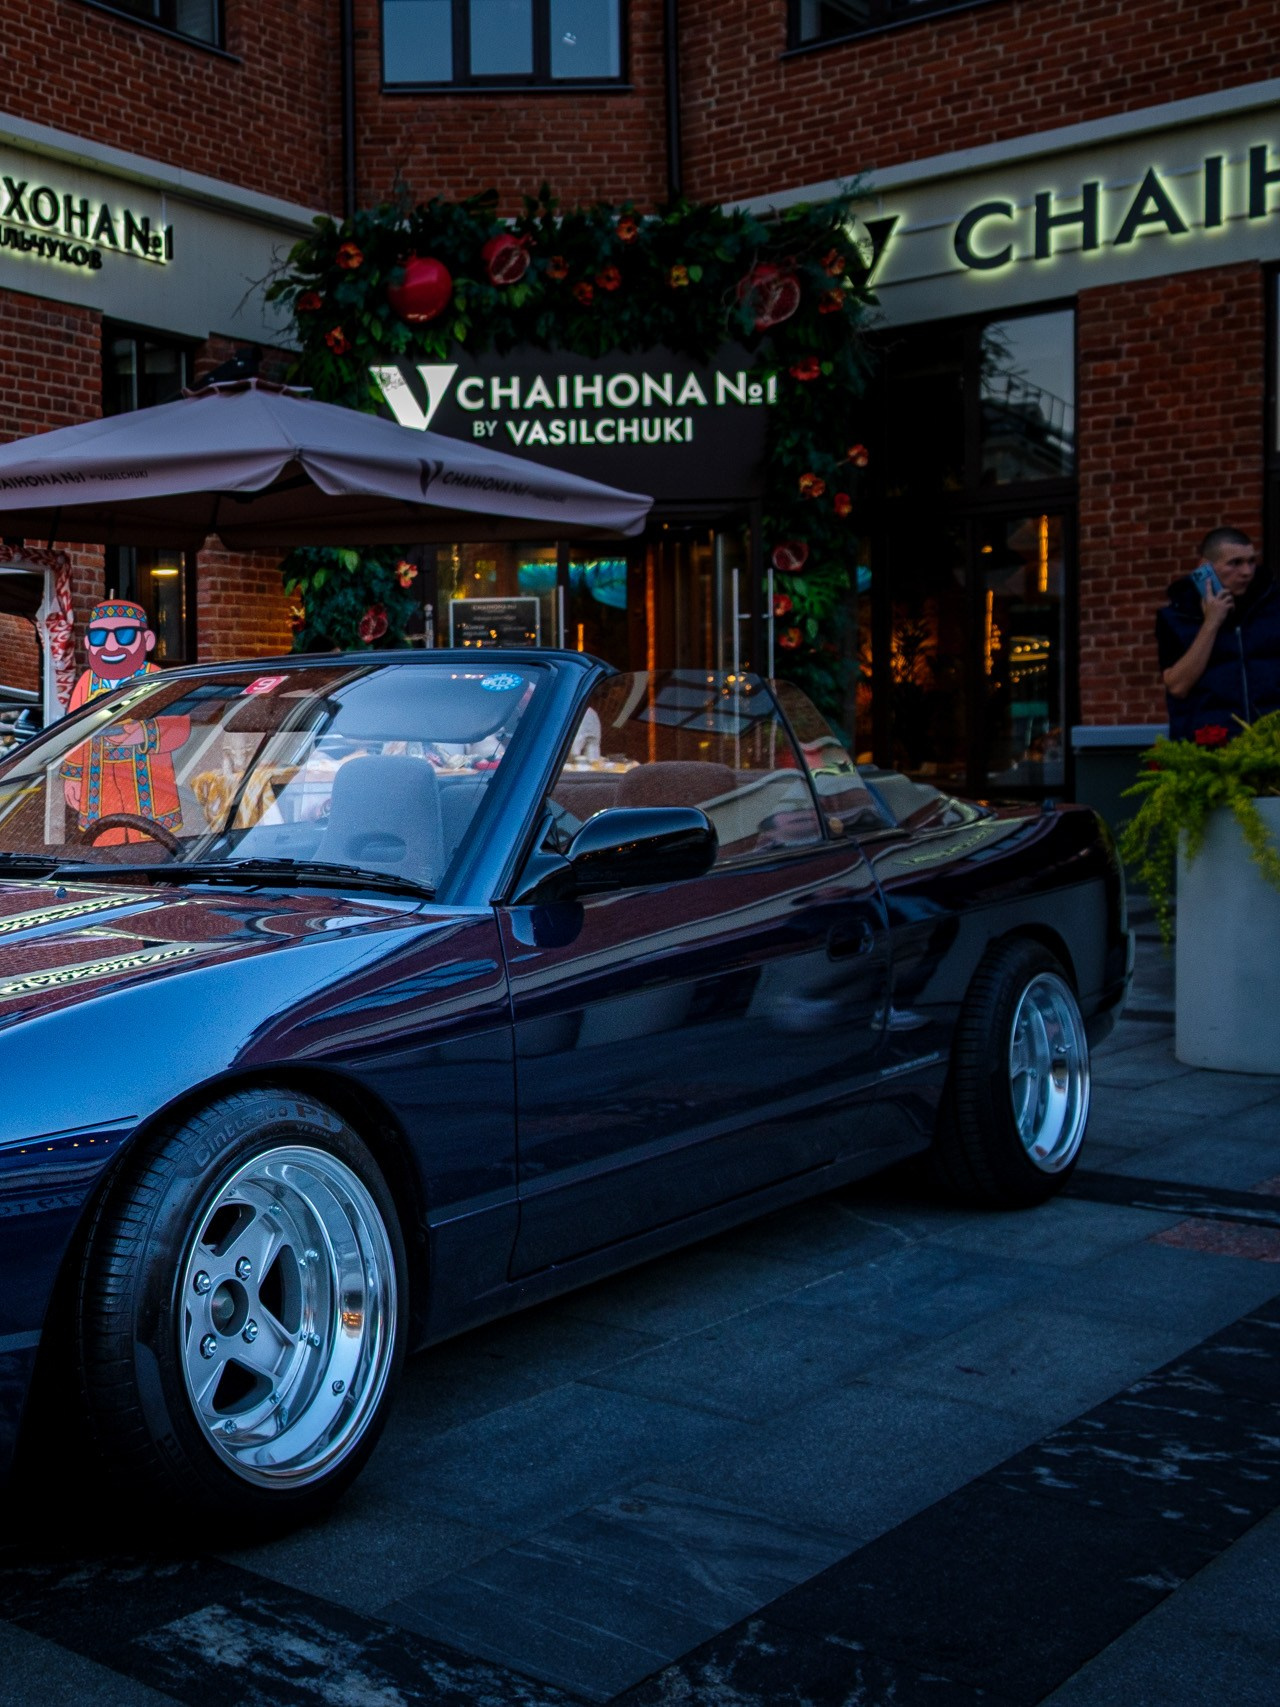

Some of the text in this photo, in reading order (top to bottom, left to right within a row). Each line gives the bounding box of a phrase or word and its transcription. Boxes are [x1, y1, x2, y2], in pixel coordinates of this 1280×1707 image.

[456, 372, 707, 411] CHAIHONA
[473, 417, 693, 446] BY VASILCHUKI
